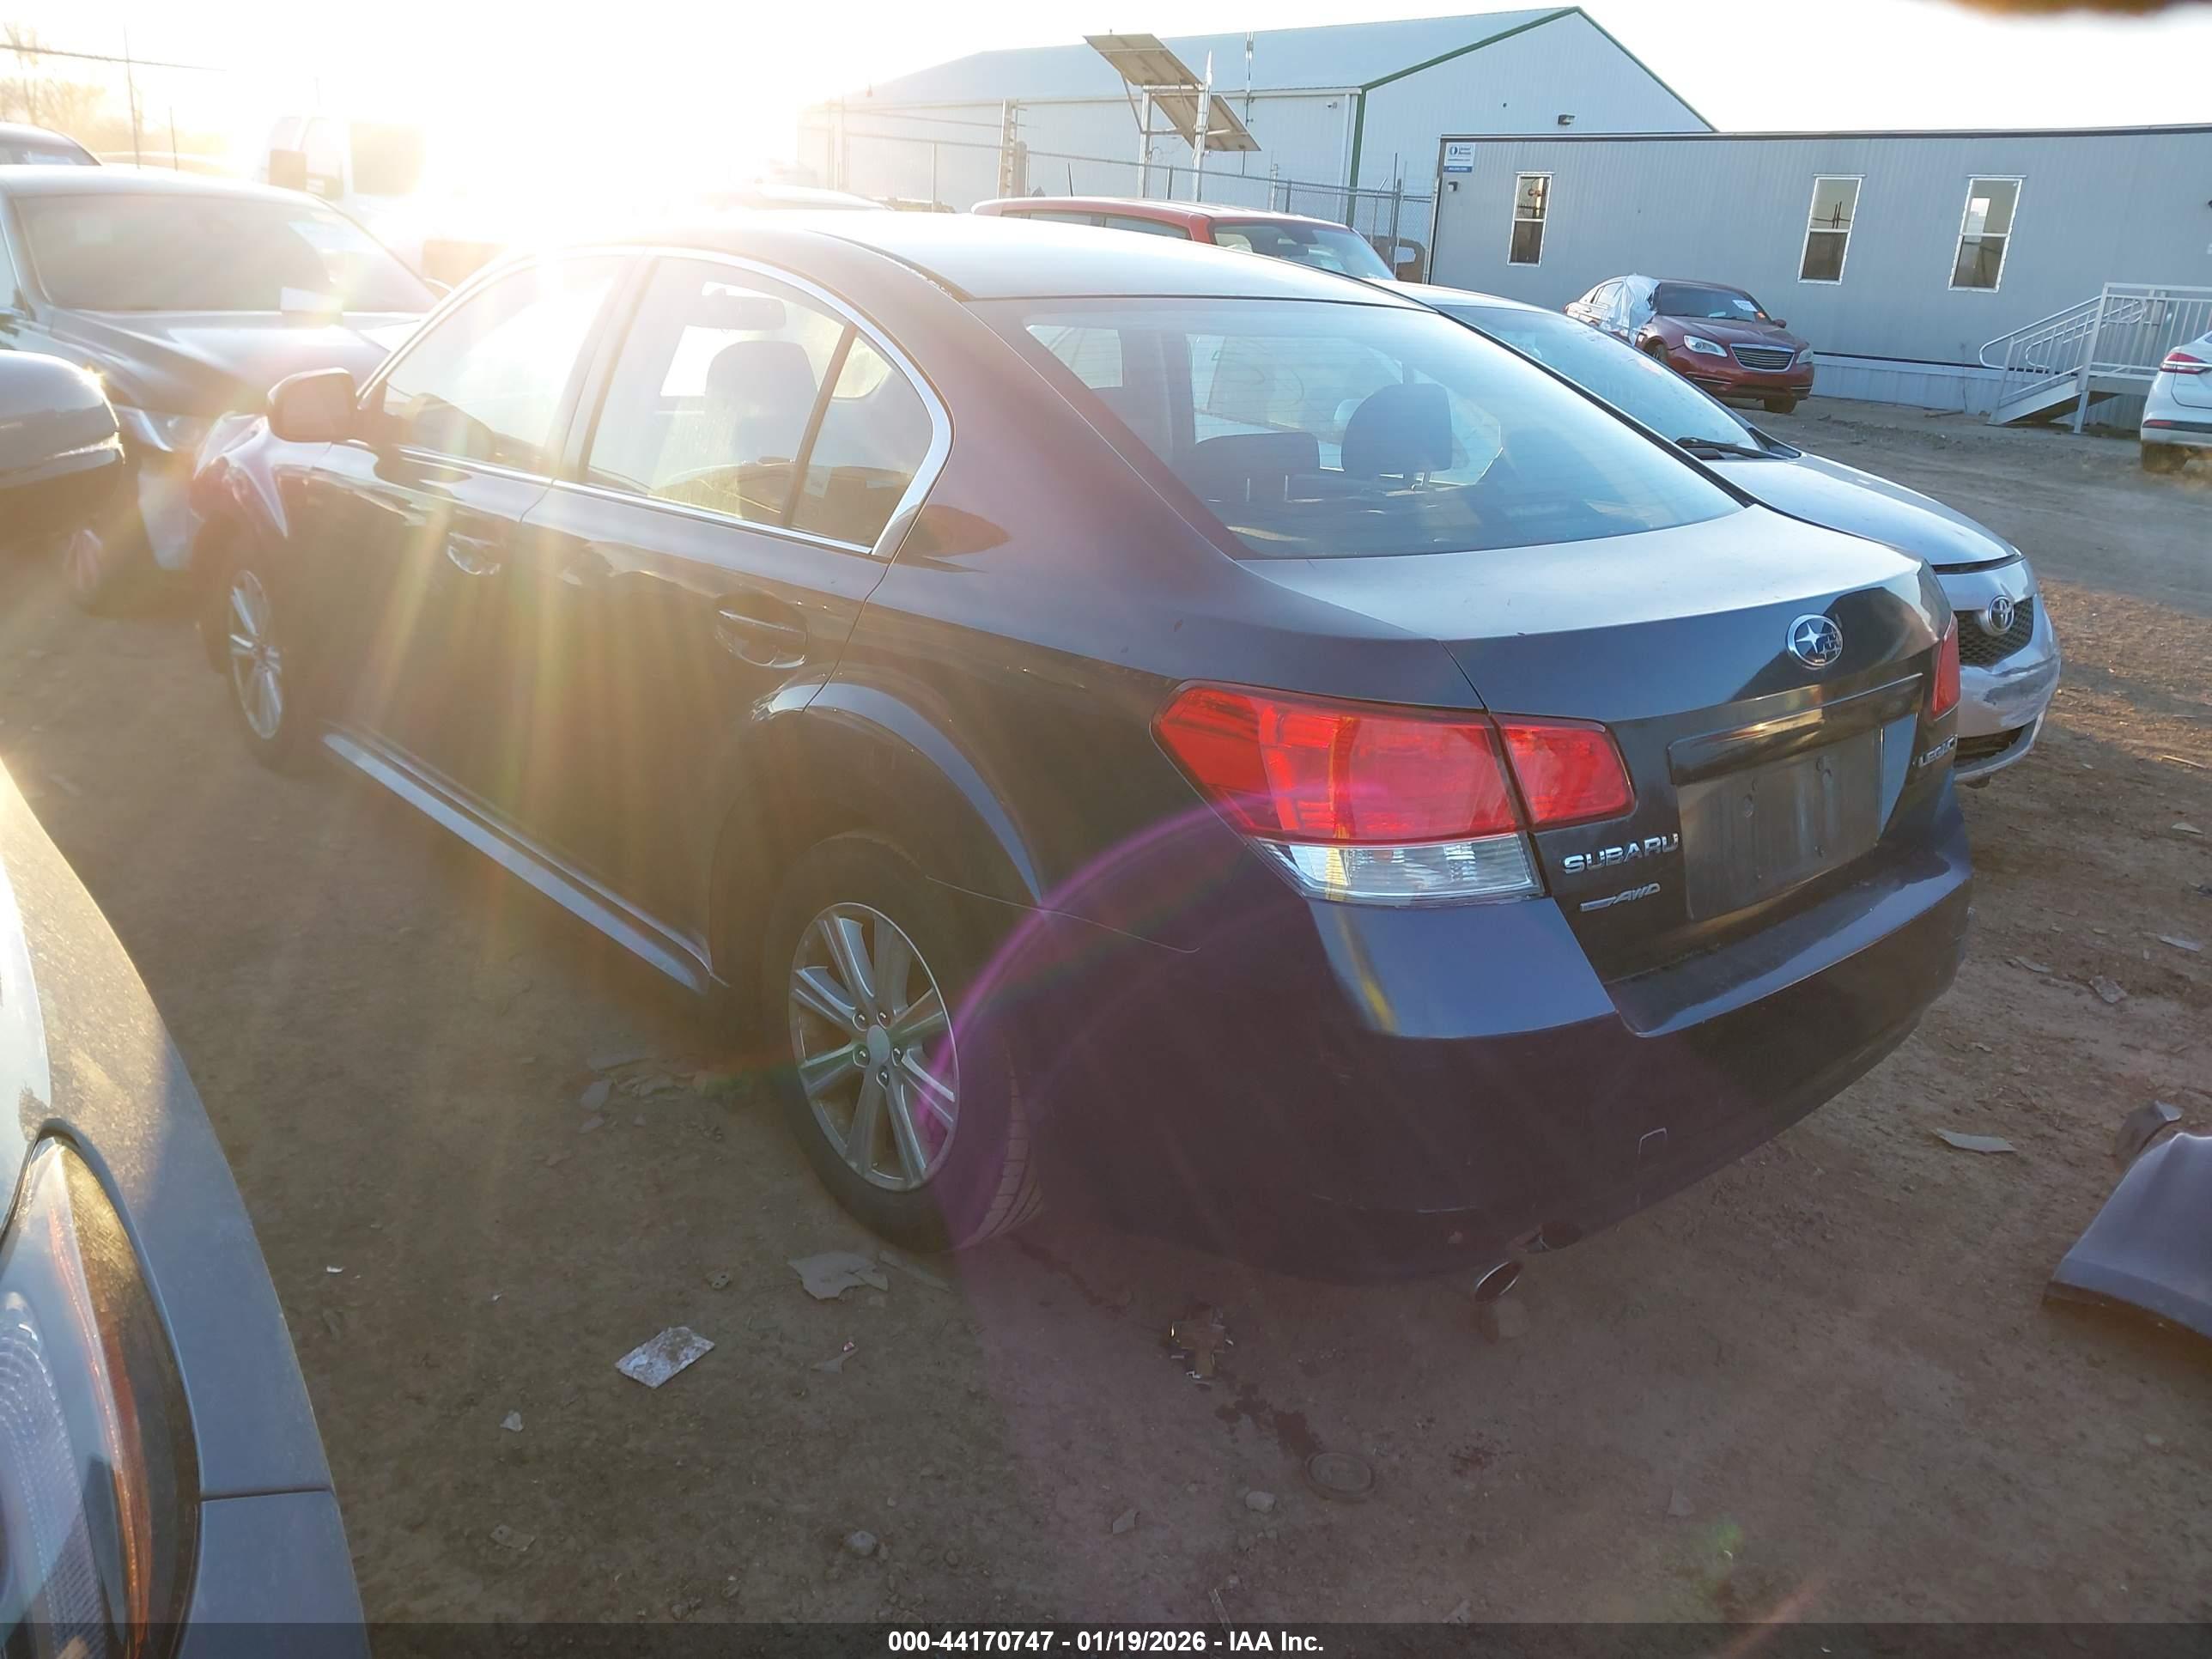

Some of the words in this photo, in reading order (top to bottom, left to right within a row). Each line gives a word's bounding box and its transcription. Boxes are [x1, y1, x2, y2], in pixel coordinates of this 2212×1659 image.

[1917, 734, 1958, 768] LEGAC
[1564, 833, 1680, 874] SUBARU
[1613, 883, 1661, 904] AWD
